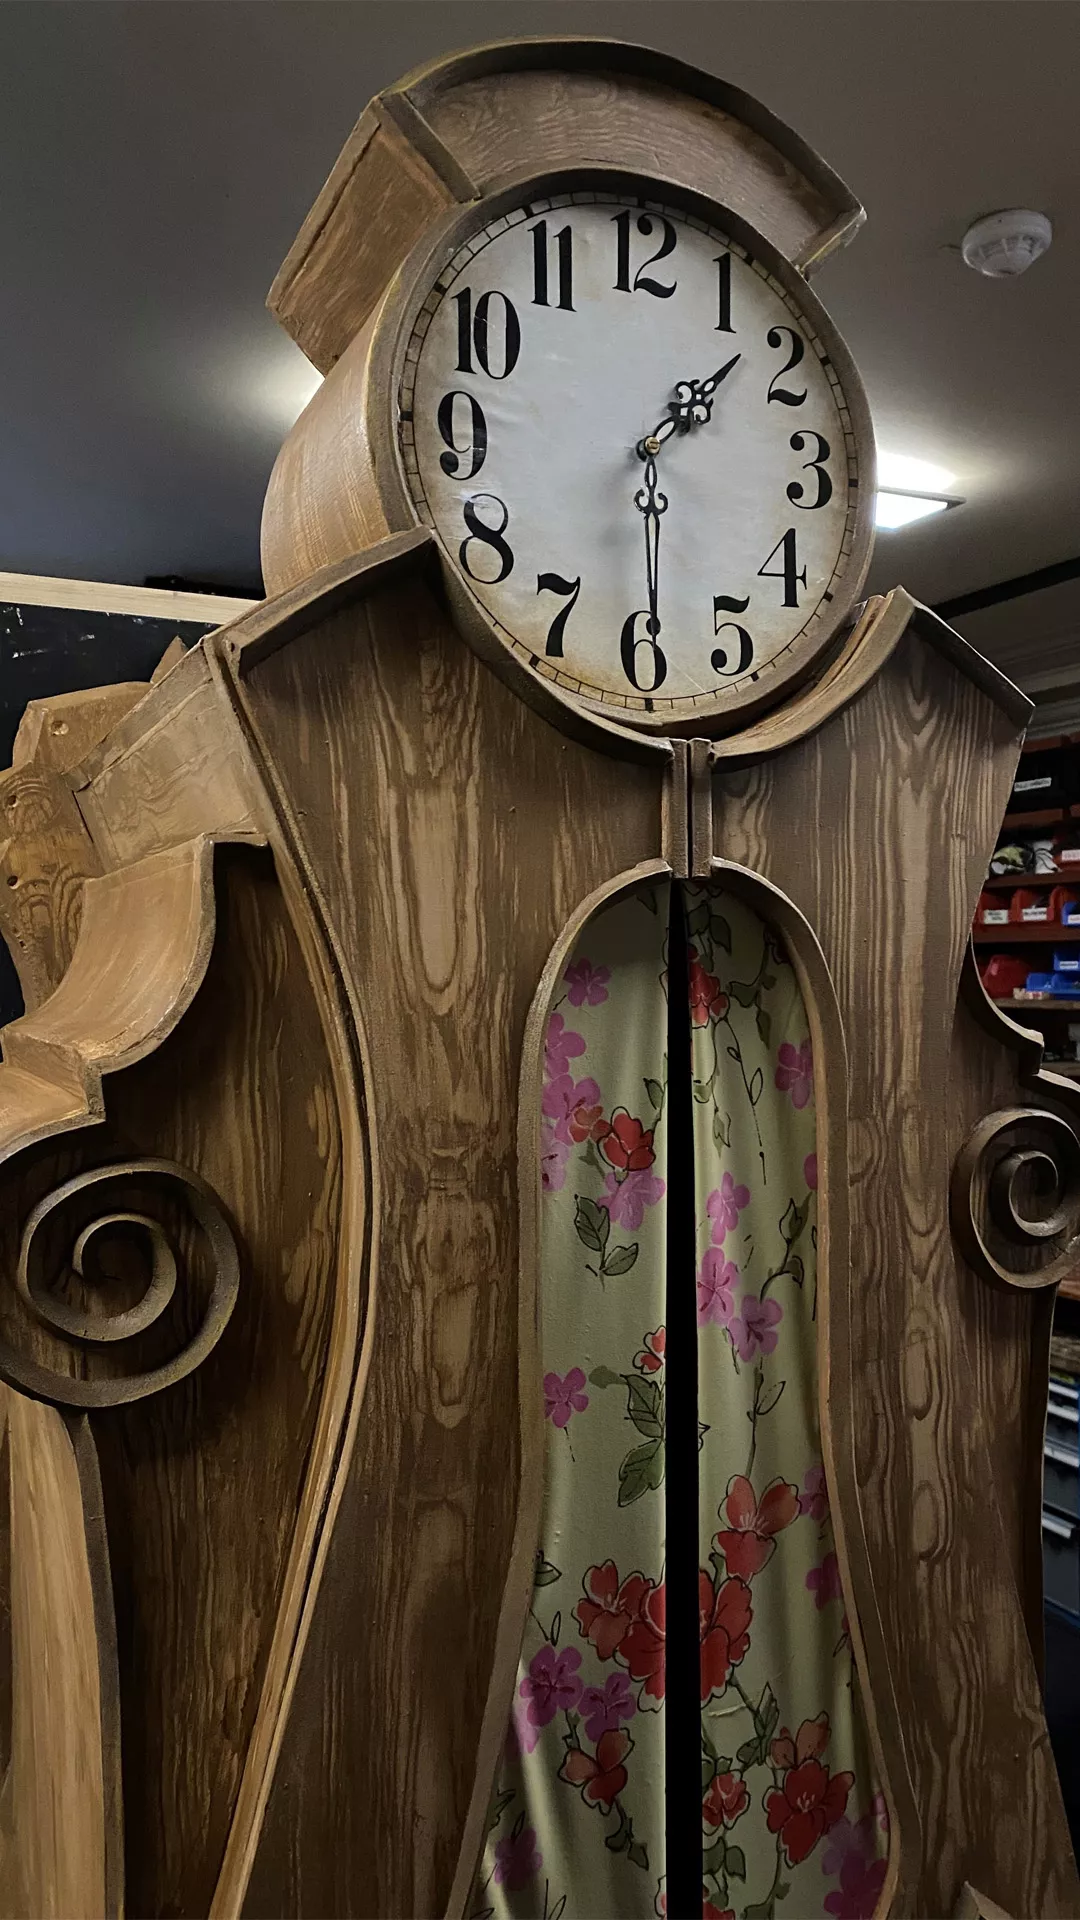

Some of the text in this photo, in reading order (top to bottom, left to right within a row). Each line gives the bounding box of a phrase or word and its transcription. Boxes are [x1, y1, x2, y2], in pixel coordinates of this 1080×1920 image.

[527, 220, 577, 313] 11
[611, 209, 678, 299] 12
[712, 252, 737, 334] 1
[451, 286, 521, 380] 10
[767, 326, 808, 407] 2
[437, 390, 488, 481] 9
[786, 430, 833, 510] 3
[459, 493, 515, 585] 8
[757, 528, 808, 608] 4
[536, 572, 581, 658] 7
[620, 610, 668, 692] 6
[710, 595, 755, 677] 5
